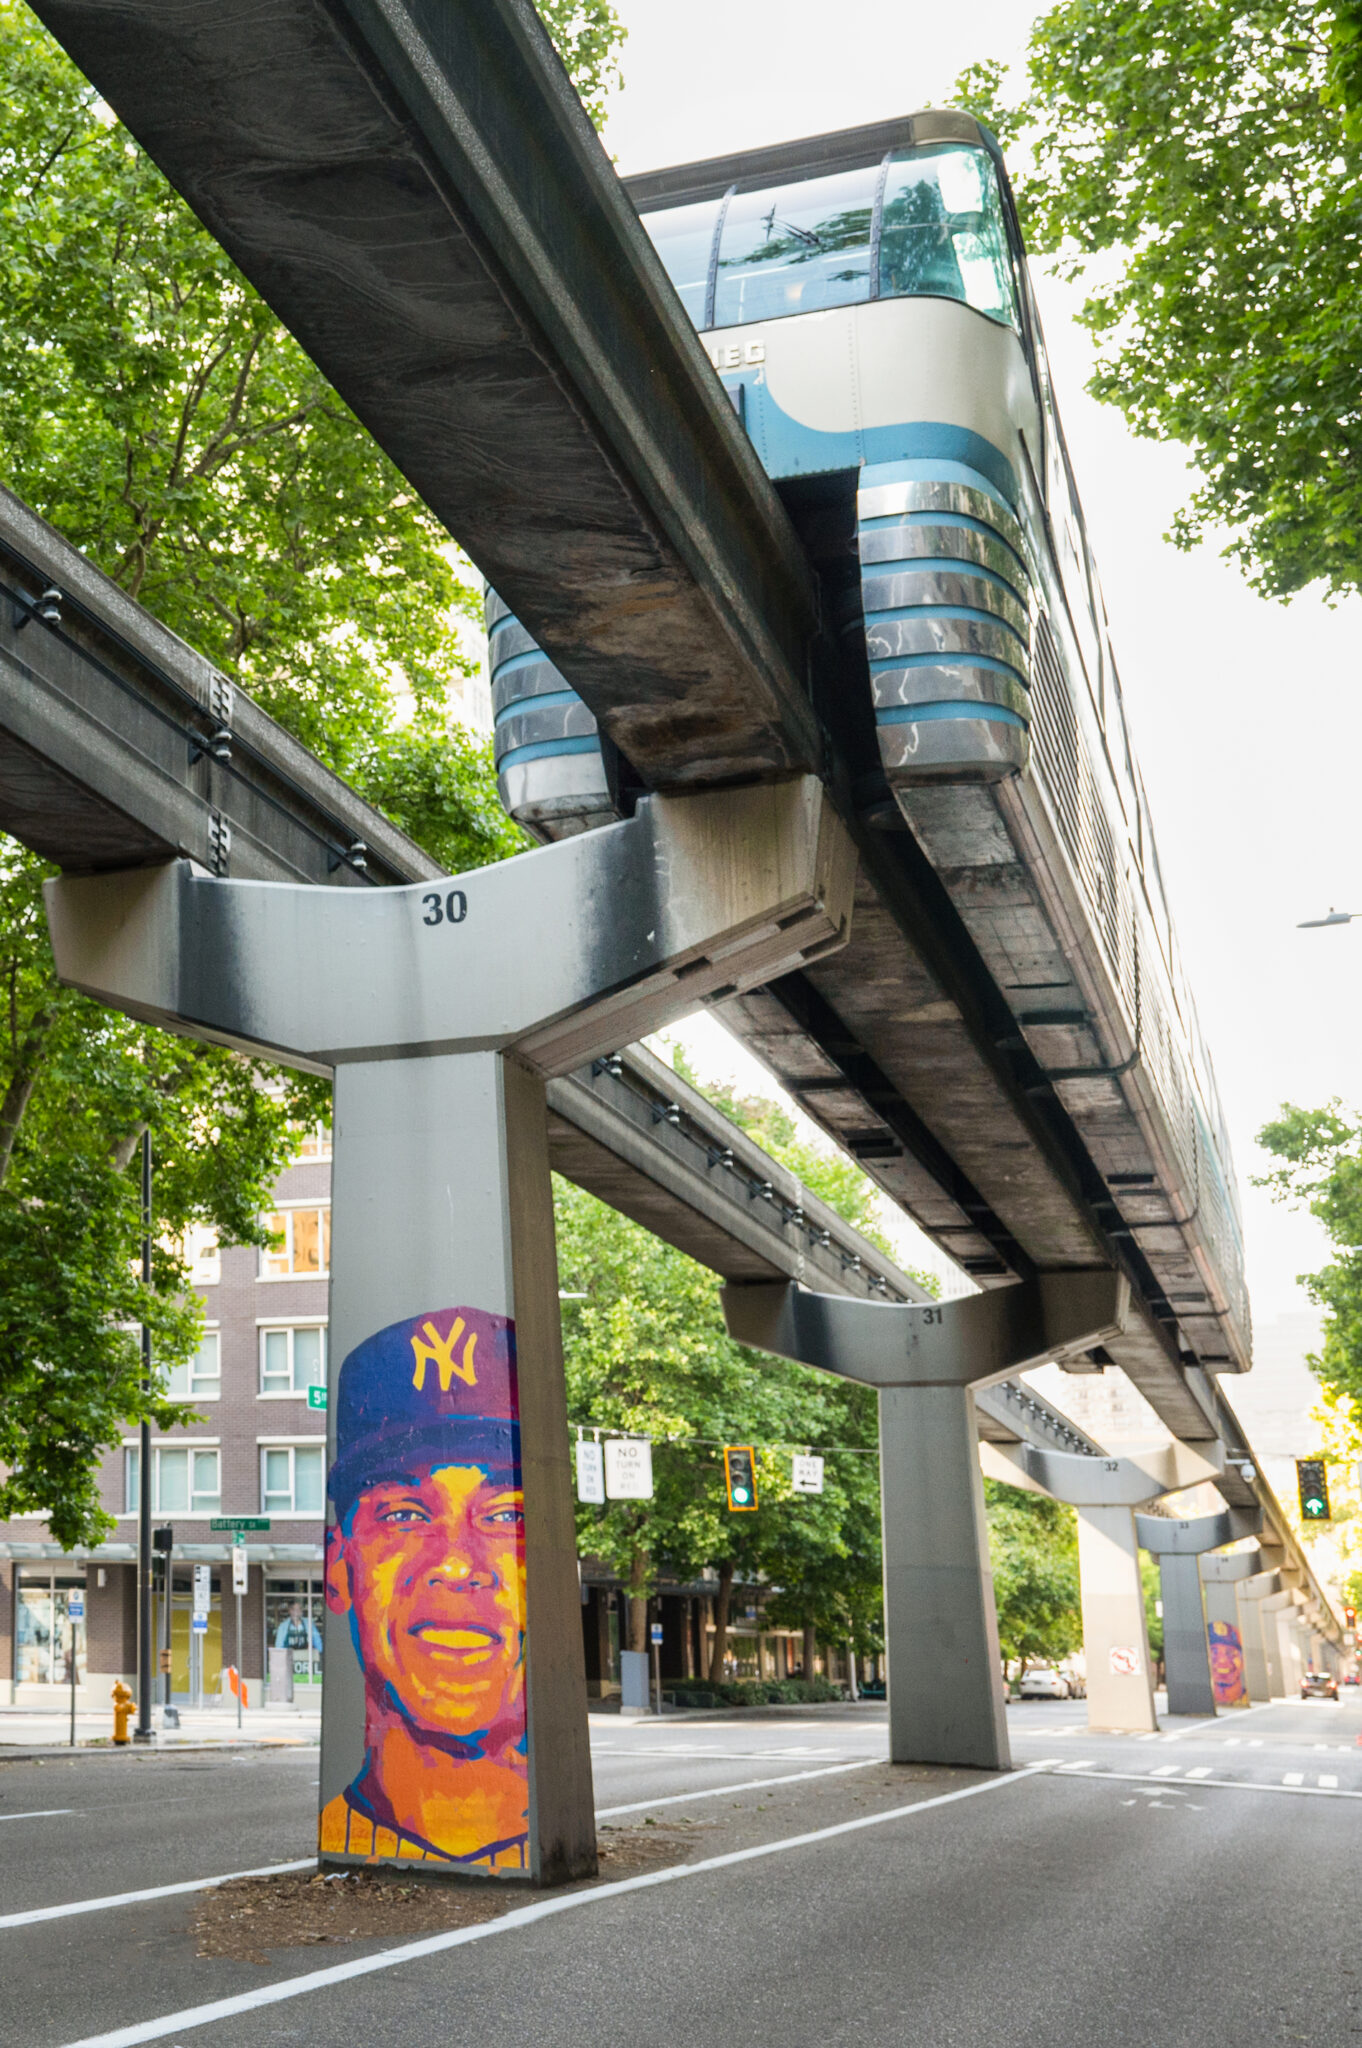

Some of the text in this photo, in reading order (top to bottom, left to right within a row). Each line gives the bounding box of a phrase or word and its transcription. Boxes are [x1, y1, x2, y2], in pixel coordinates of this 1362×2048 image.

[422, 890, 467, 926] 30
[923, 1307, 942, 1325] 31
[410, 1316, 478, 1391] NY
[618, 1447, 637, 1457] NO
[616, 1461, 640, 1470] TURN
[799, 1459, 817, 1469] ONE
[622, 1471, 635, 1480] ON
[799, 1469, 817, 1478] WAY
[211, 1519, 245, 1530] Battery
